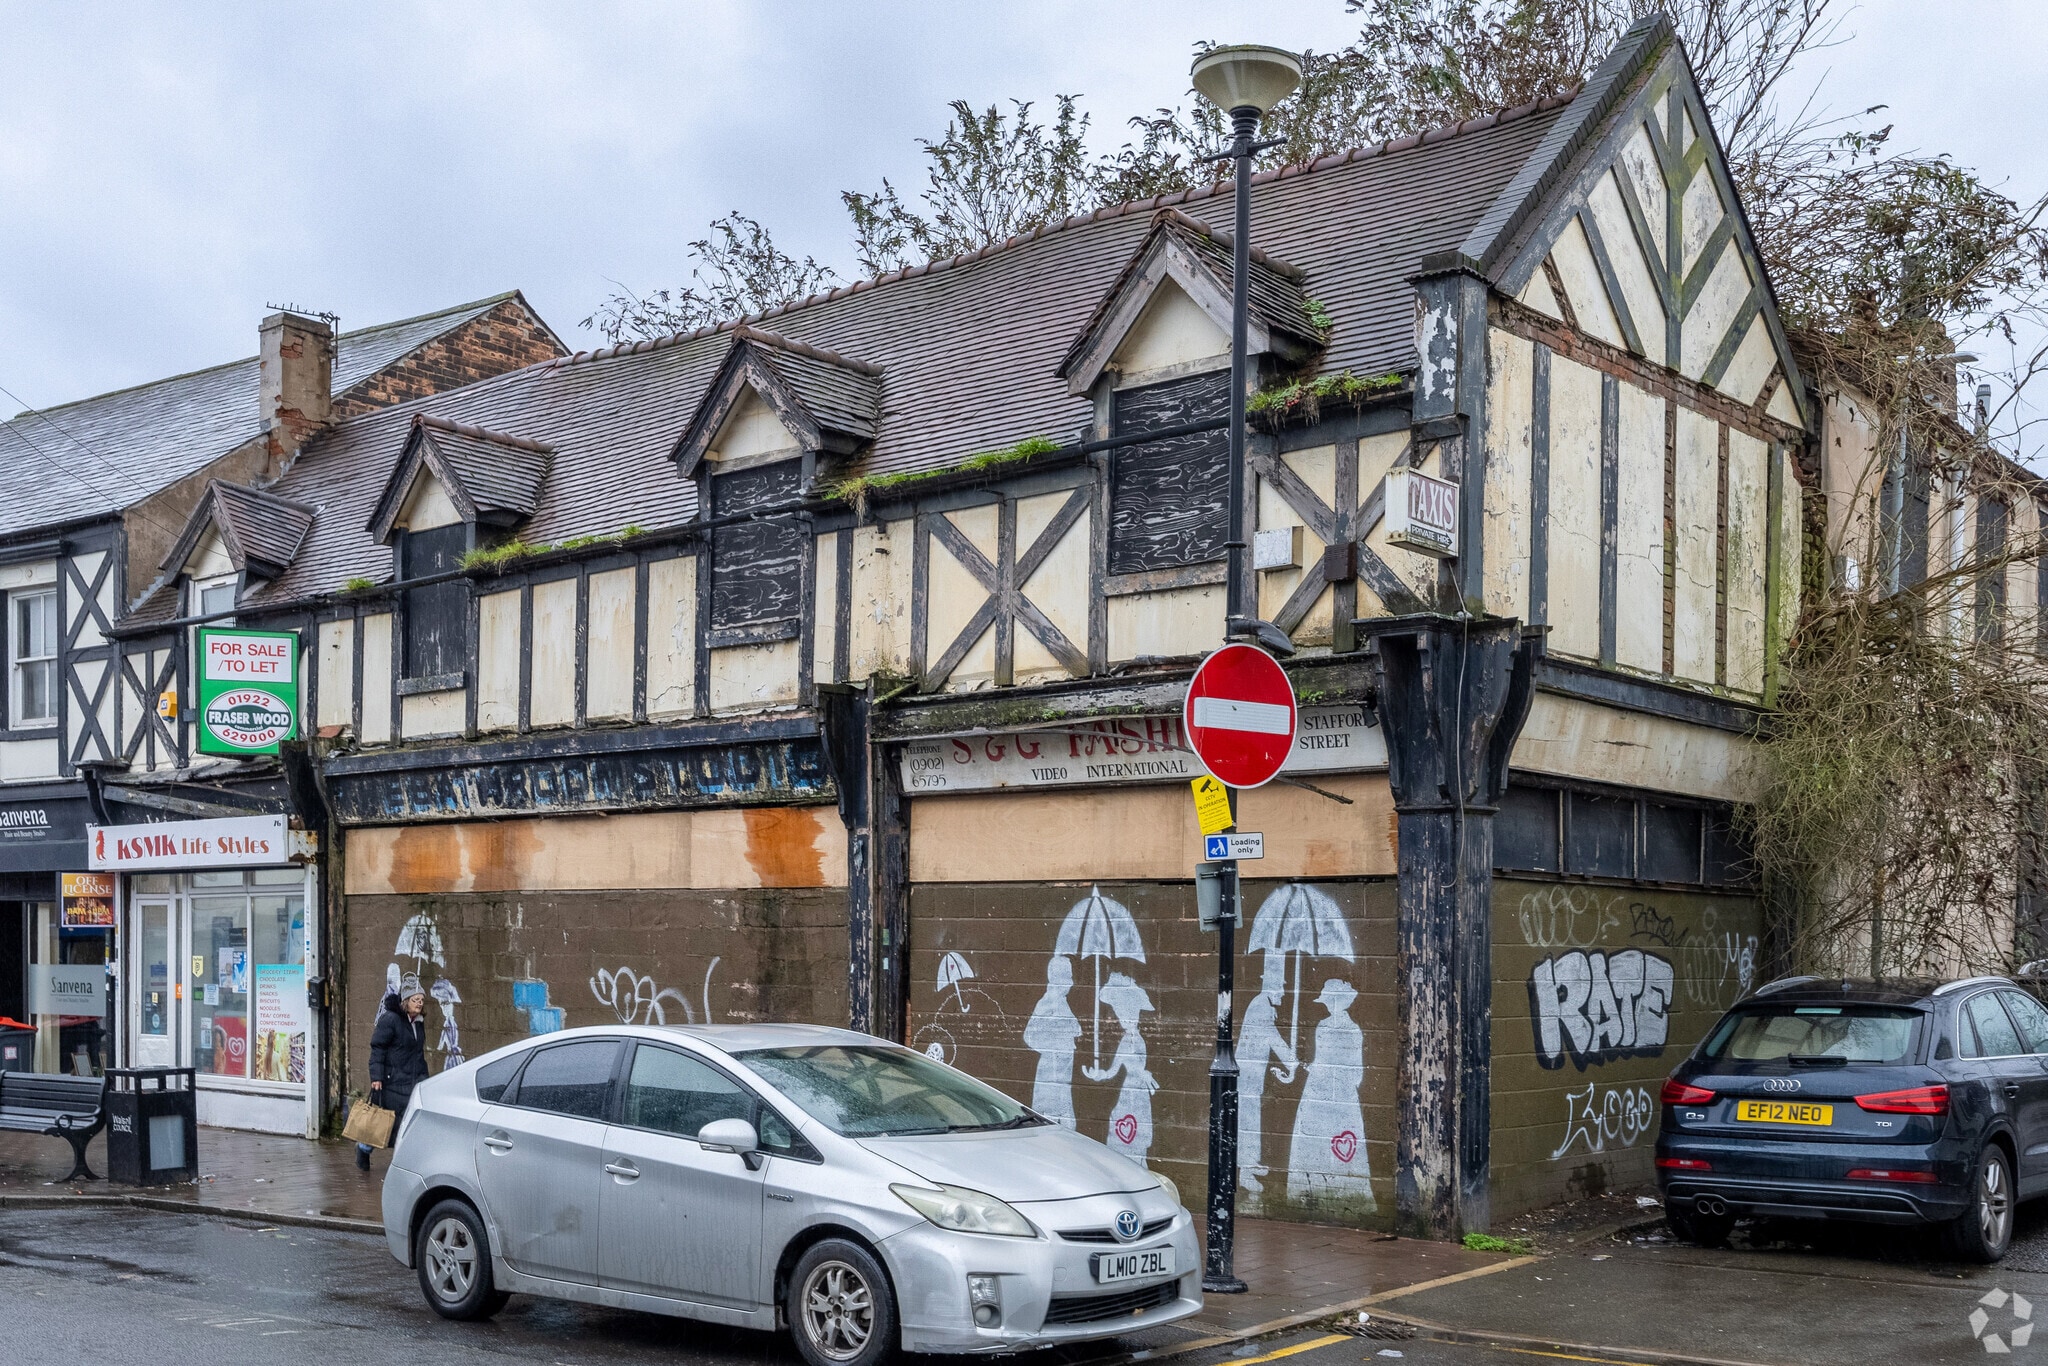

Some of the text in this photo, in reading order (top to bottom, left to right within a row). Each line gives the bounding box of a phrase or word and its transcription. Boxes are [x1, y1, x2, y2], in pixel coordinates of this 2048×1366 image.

[1408, 476, 1455, 530] TAXIS
[1411, 525, 1435, 541] PRIVATE
[1437, 533, 1450, 545] HIRE
[211, 642, 287, 657] FOR SALE
[218, 660, 279, 673] /TO LET
[228, 694, 270, 707] 01922
[208, 711, 289, 725] FRASER WOOD
[1304, 713, 1366, 730] STAFFOR
[222, 728, 276, 743] 629000
[1299, 734, 1350, 750] STREET
[905, 745, 942, 755] TELEPHONE
[909, 757, 945, 774] (0902)
[1031, 760, 1188, 781] VIDEO INTERNATIONAL
[912, 774, 947, 788] 65795
[117, 833, 270, 860] KSMK Life Styles
[1230, 838, 1260, 854] Loading only
[75, 876, 99, 886] OFF
[64, 884, 112, 896] LICENSE
[51, 976, 93, 994] Sanvena
[1528, 947, 1675, 1071] RATE
[1747, 1103, 1822, 1122] EF12 NEO
[1107, 1252, 1167, 1278] LM10 ZBL
